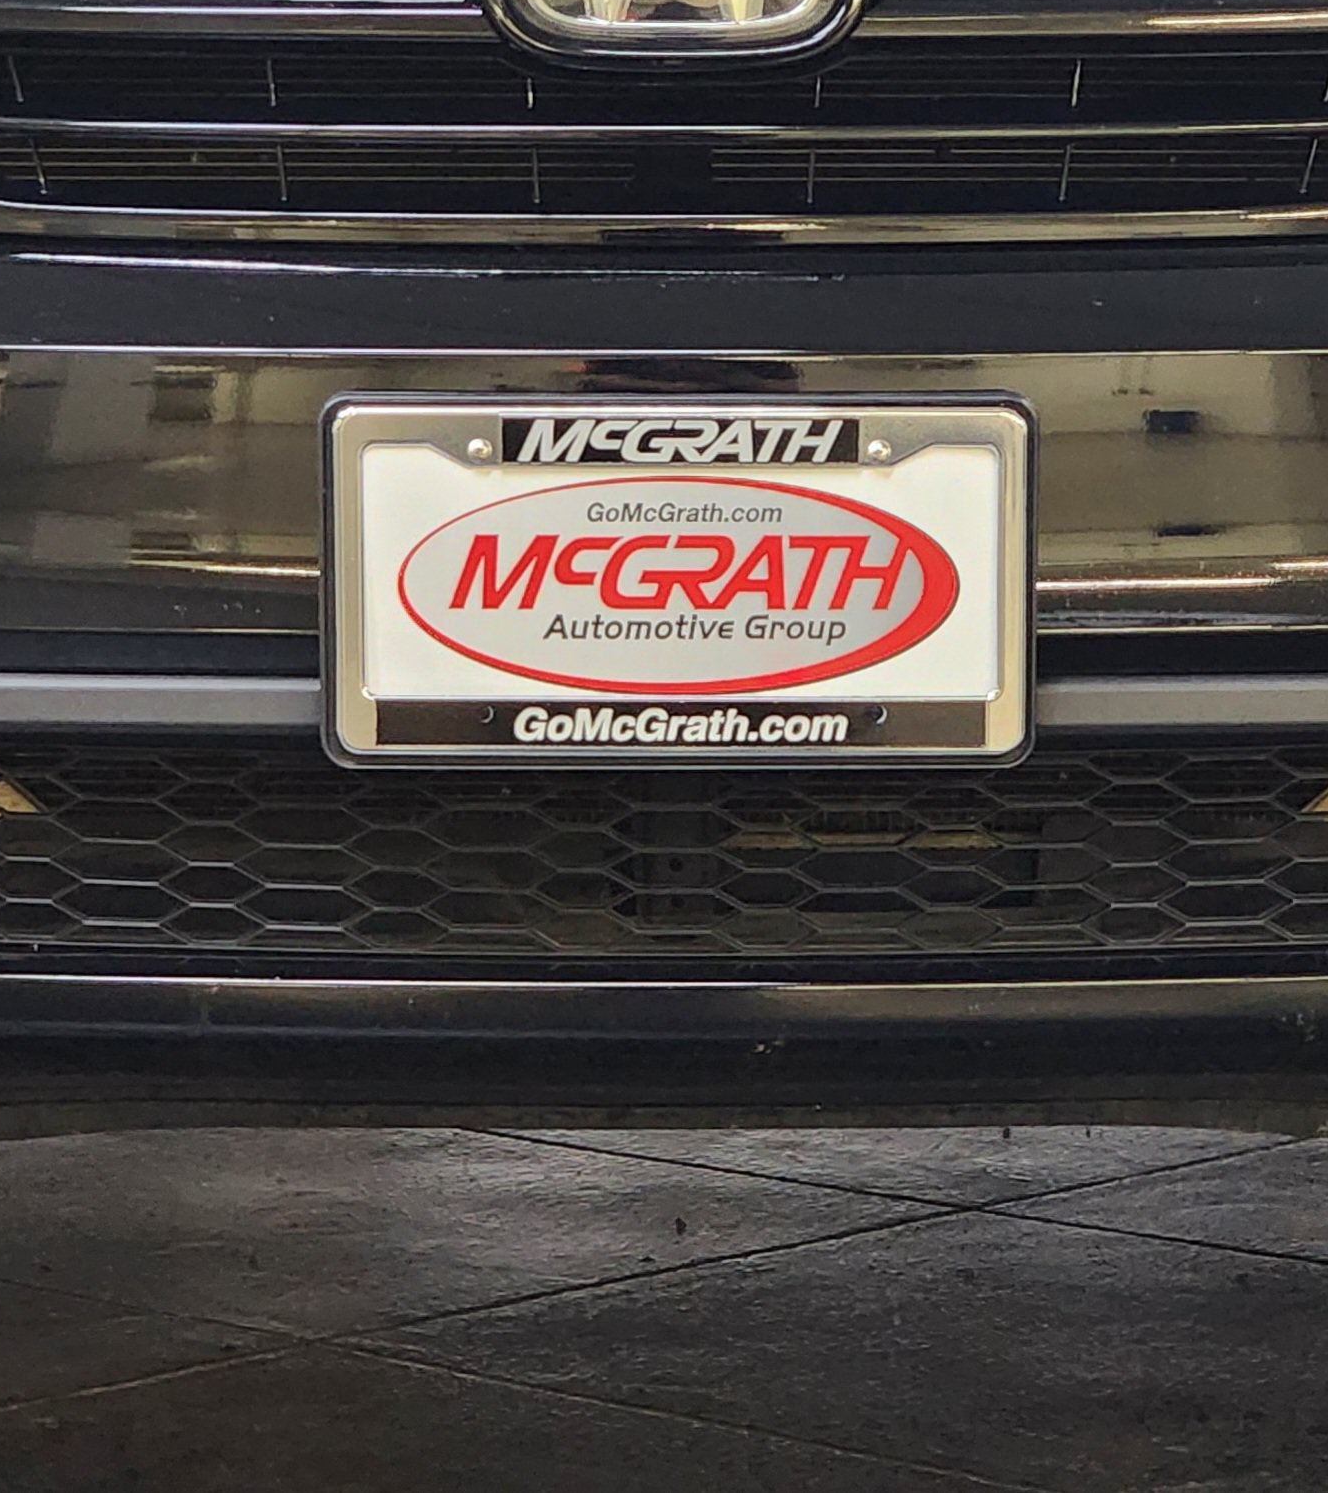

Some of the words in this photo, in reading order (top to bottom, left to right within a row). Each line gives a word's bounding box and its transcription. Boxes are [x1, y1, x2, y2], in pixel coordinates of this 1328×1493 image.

[586, 502, 783, 524] GoMcGrath.com
[542, 613, 735, 640] Automotive
[744, 614, 847, 646] Group
[513, 707, 849, 743] GoMcGrath.com
